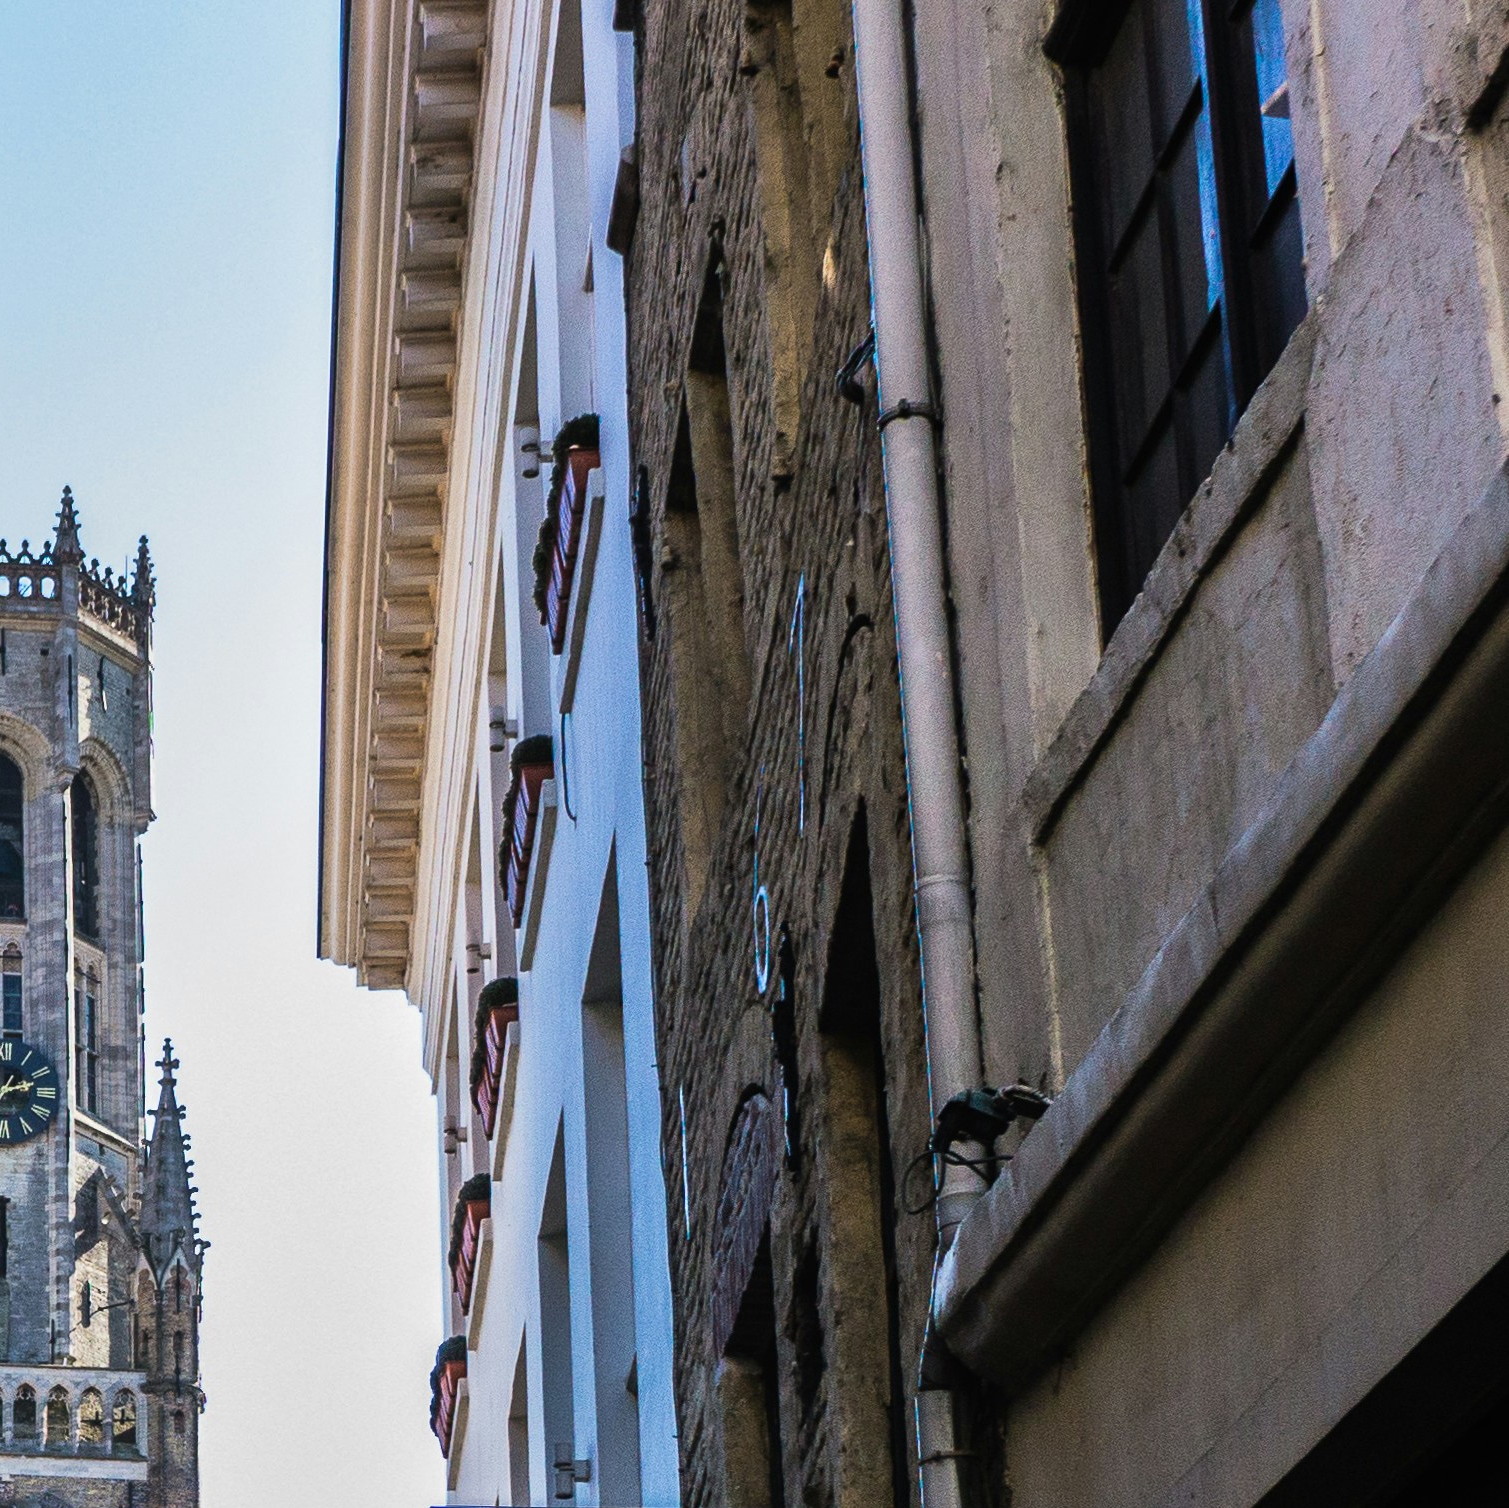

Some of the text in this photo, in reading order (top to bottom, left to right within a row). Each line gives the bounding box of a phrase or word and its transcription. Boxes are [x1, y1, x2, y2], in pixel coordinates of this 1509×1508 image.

[31, 1066, 50, 1079] II
[37, 1088, 55, 1099] III
[31, 1104, 51, 1121] IV
[19, 1117, 33, 1135] V
